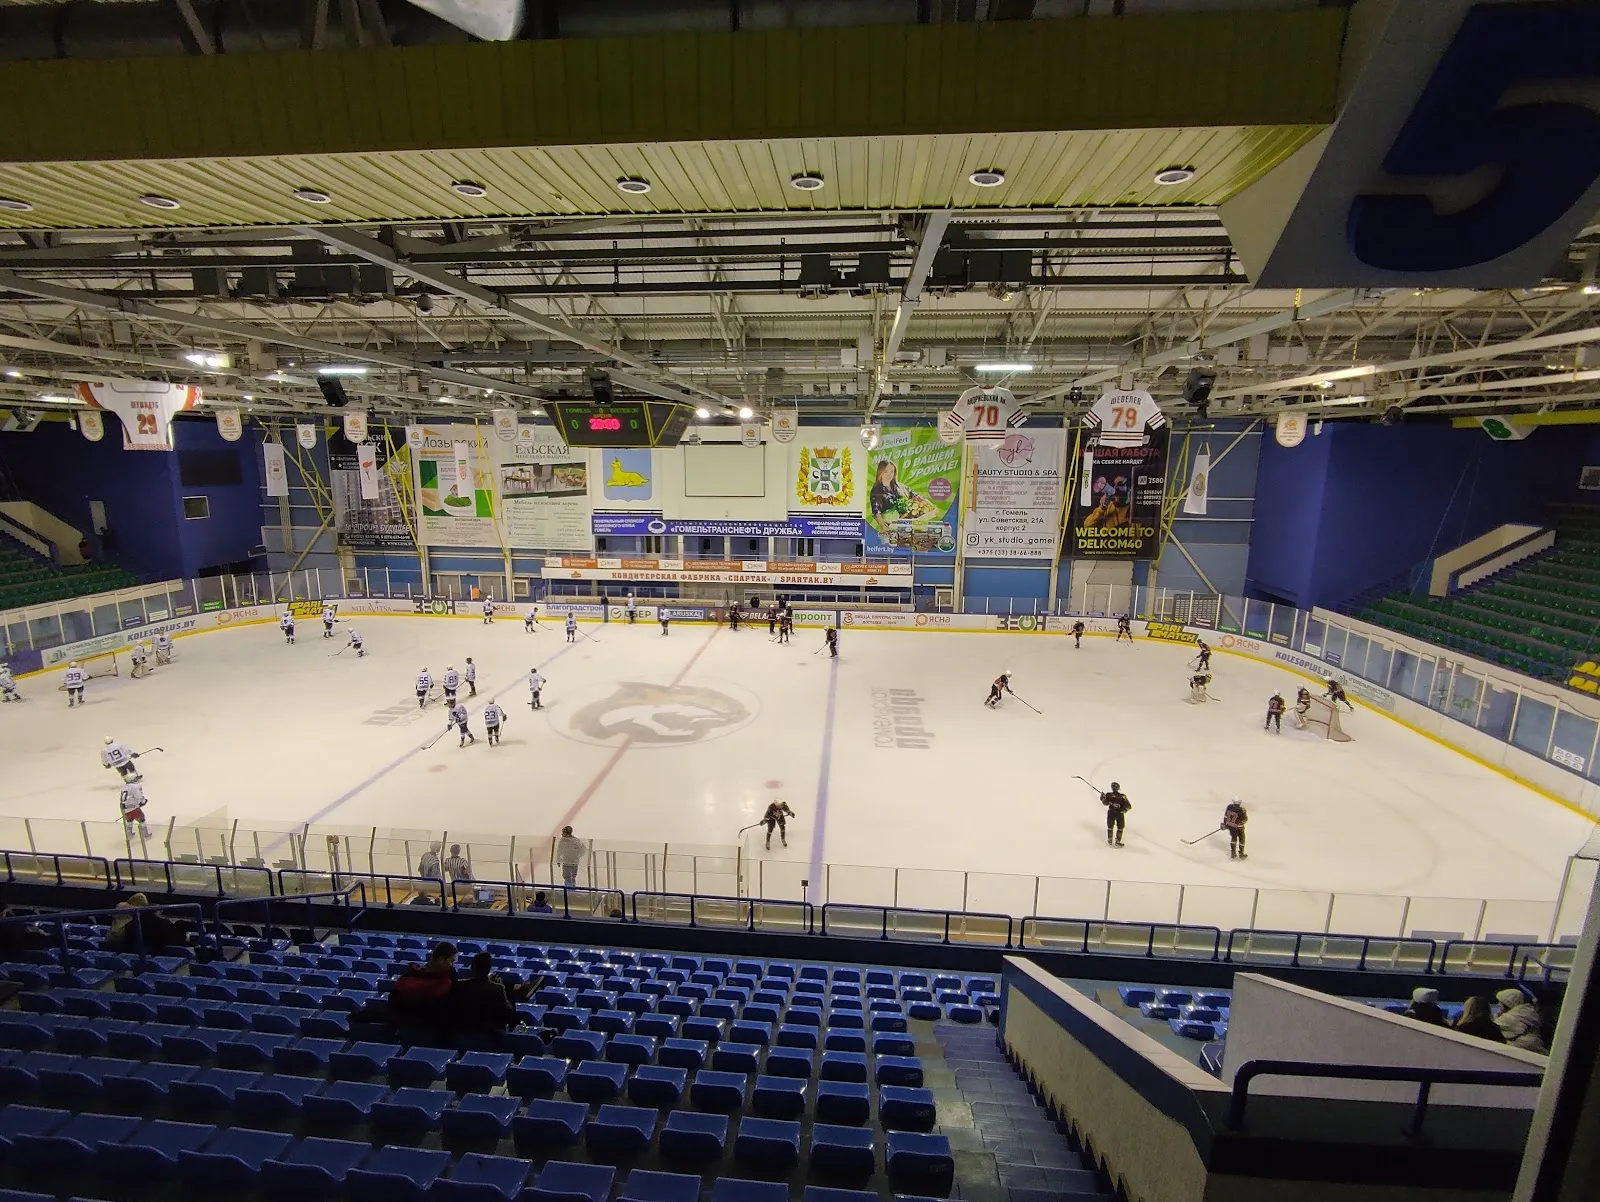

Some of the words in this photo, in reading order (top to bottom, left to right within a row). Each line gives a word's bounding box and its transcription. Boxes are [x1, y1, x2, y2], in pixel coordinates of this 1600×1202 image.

[974, 405, 1000, 427] 70
[1111, 407, 1138, 428] 79
[137, 414, 158, 434] 29
[571, 419, 579, 430] 0
[630, 419, 638, 430] 0
[913, 449, 955, 467] ВАШЕМ
[1121, 448, 1160, 457] РАБОТА
[909, 459, 959, 479] УРОЖАЕ!
[670, 525, 762, 535] «ГОМЕЛЬТРАНСНЕФТЬ
[763, 527, 803, 536] ДРУЖБА»
[1076, 527, 1136, 537] WELCOME
[1137, 527, 1154, 537] TO
[984, 536, 1055, 545] yk_studio_gomel
[1078, 538, 1143, 549] DELKOM40
[611, 572, 677, 580] КОНДИТЕРСКАЯ
[680, 573, 721, 581] ФАБРИКА
[780, 576, 834, 584] SPARTAK.BY
[484, 710, 496, 720] 23
[107, 749, 122, 760] 19
